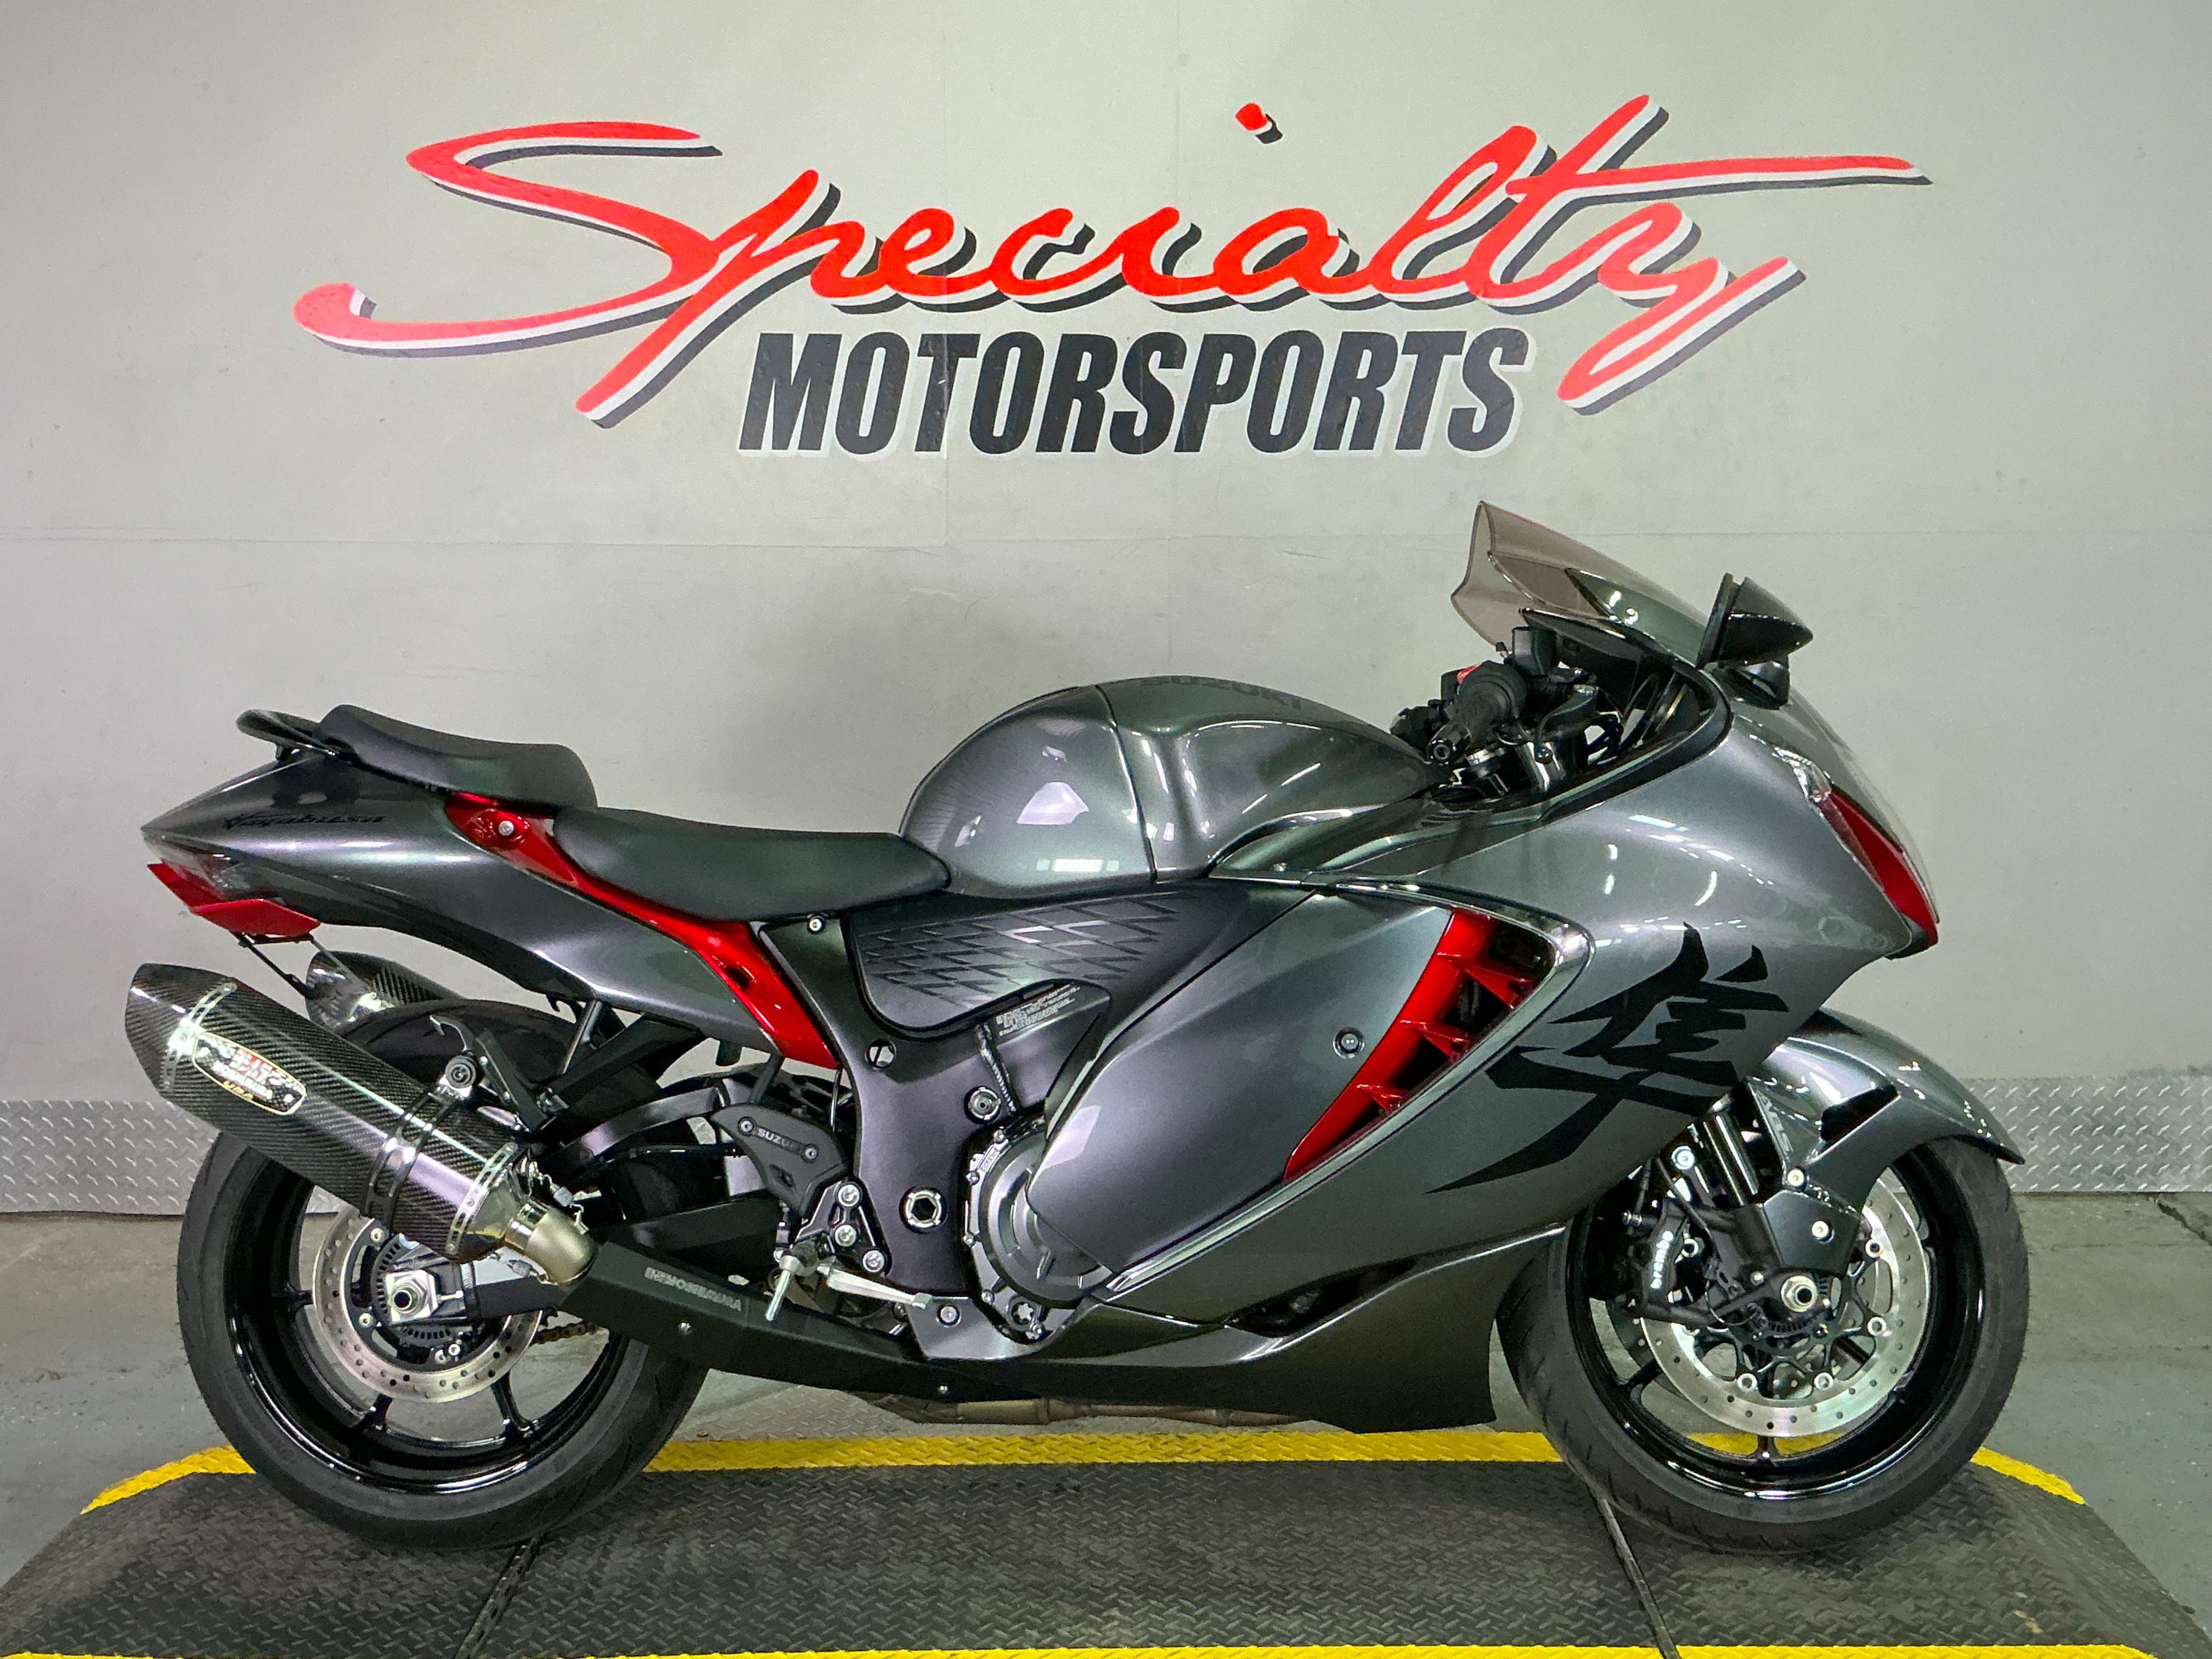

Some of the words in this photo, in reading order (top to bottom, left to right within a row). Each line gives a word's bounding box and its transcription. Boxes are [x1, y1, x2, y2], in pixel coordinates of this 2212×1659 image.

[294, 94, 1932, 427] Specialty
[738, 328, 1532, 456] MOTORSPORTS
[757, 1127, 800, 1151] SUZU
[1650, 1230, 1674, 1289] brembo
